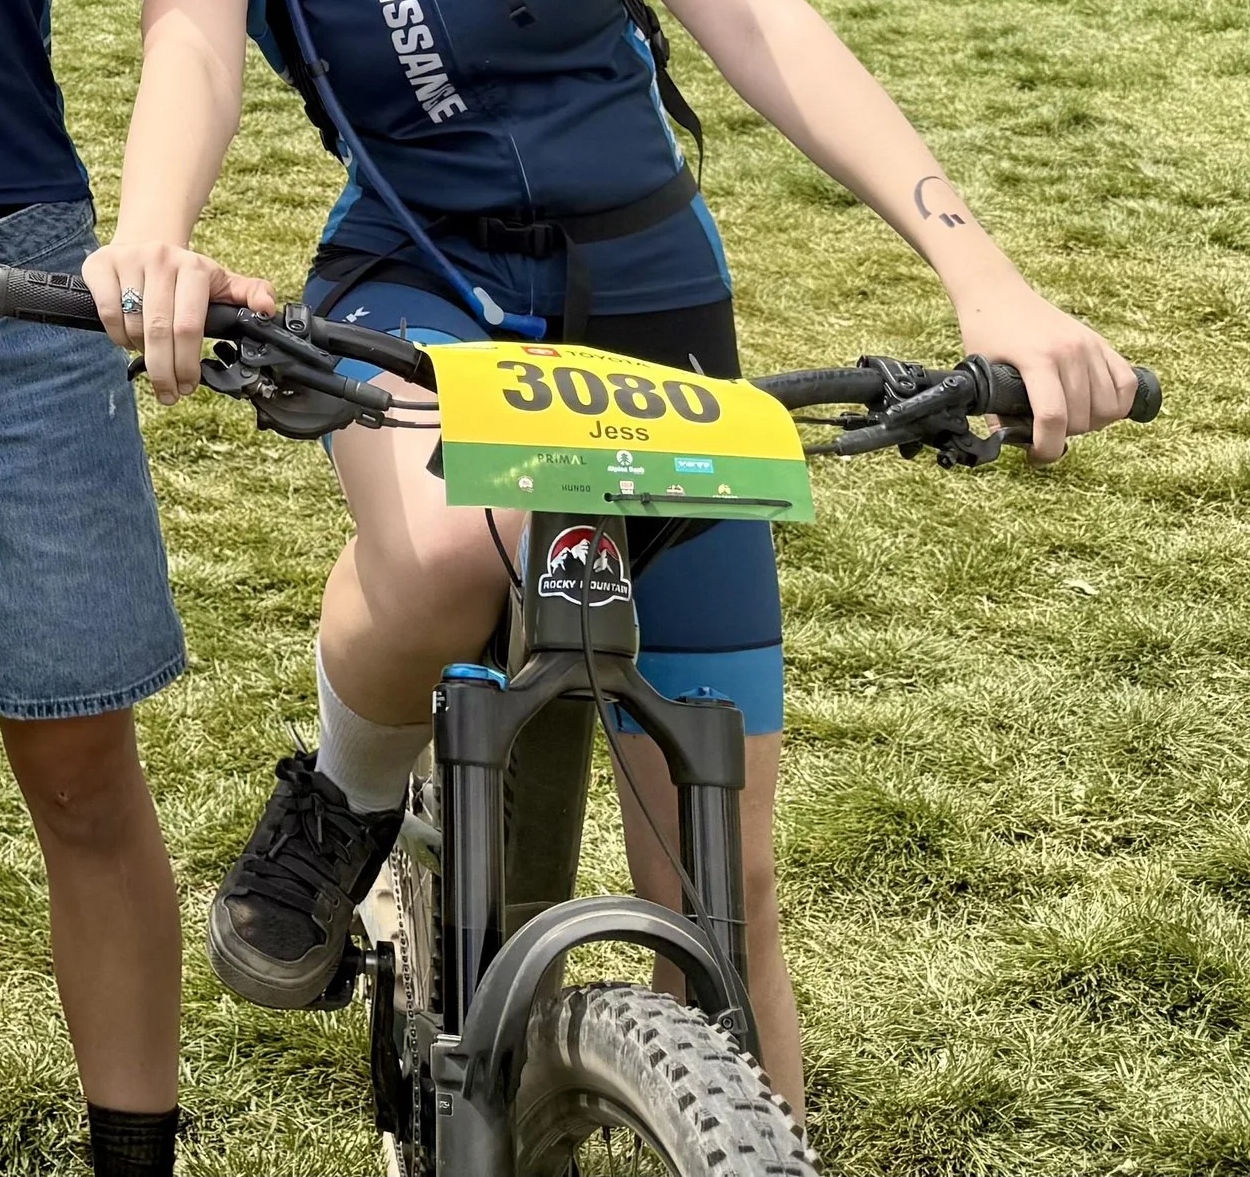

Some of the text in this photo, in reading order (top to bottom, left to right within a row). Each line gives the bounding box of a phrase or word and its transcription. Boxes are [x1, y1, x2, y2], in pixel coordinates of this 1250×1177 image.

[565, 350, 650, 369] TOYOTA
[496, 360, 720, 424] 3080
[589, 420, 650, 442] Jess
[537, 454, 587, 465] PRIMAL
[543, 580, 628, 594] ROCKY OUNTAIN
